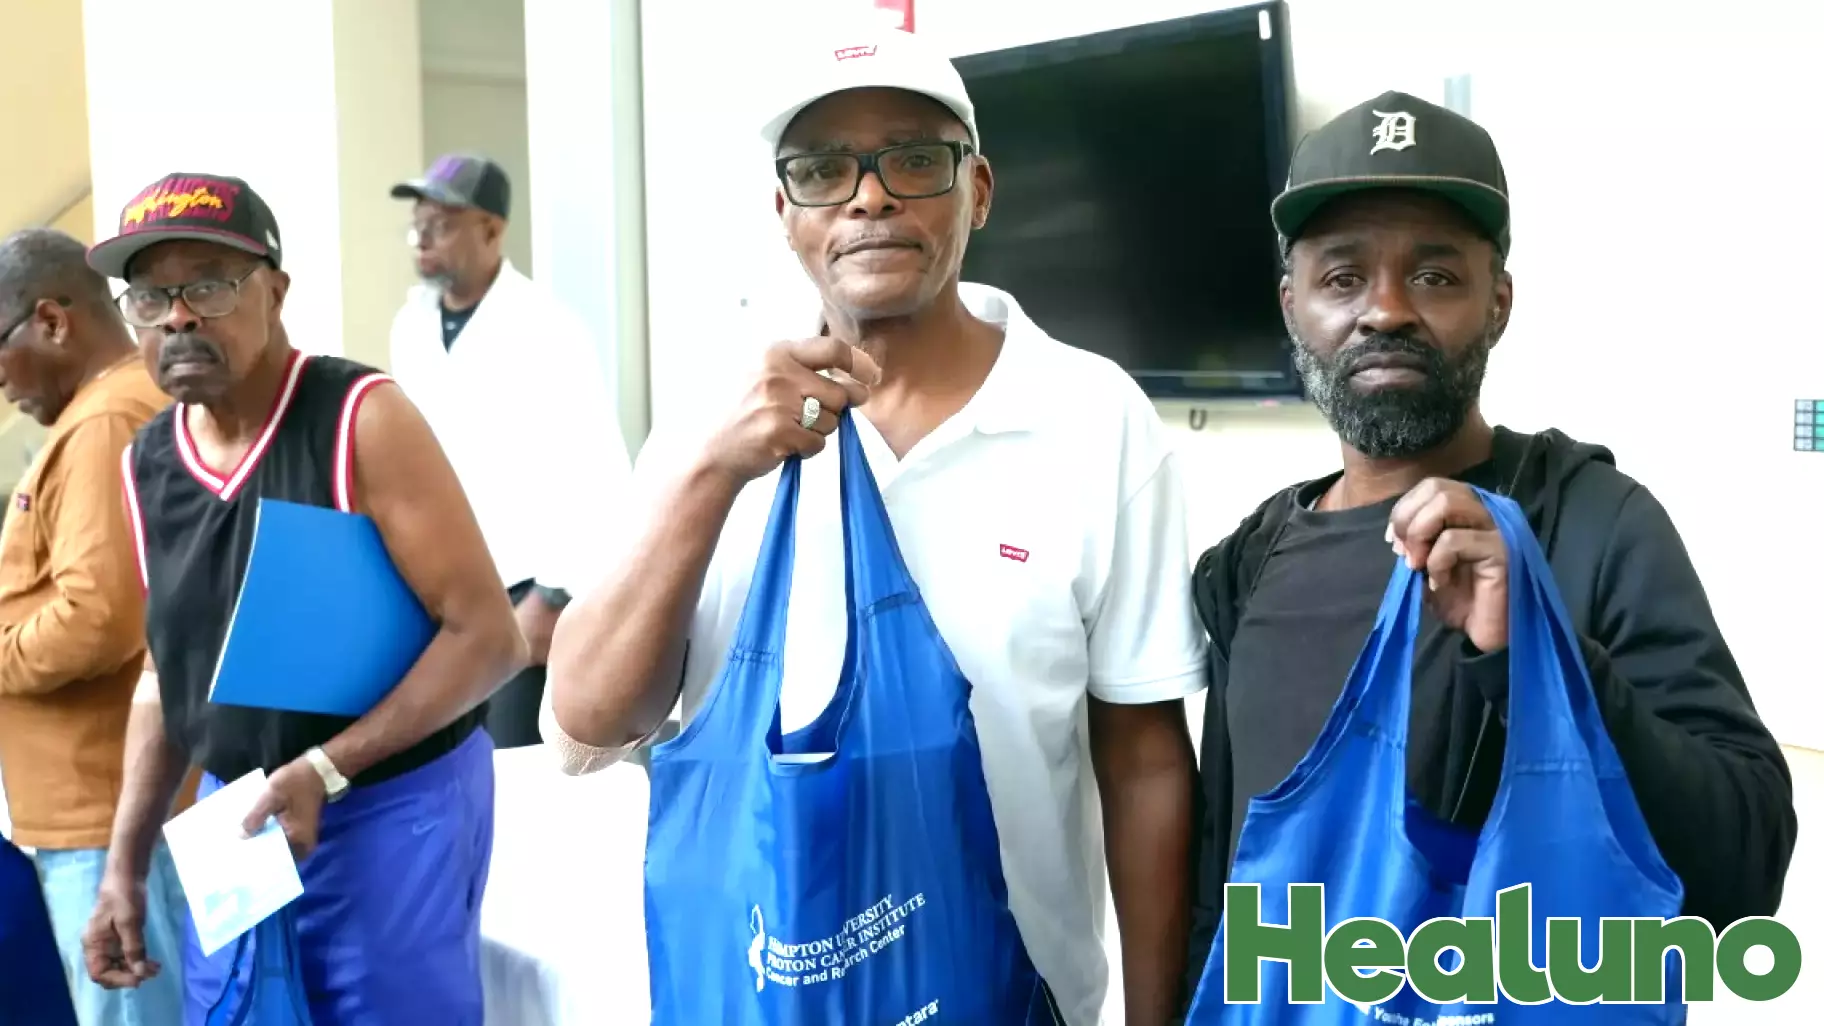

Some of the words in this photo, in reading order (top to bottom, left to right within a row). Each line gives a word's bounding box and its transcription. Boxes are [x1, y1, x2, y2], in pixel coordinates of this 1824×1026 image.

[1370, 109, 1417, 155] D
[820, 937, 857, 967] CAR
[858, 892, 926, 944] INSTITUTE
[835, 893, 893, 947] UVERSITY
[802, 969, 828, 985] and
[831, 947, 868, 980] Rarch
[869, 924, 905, 953] Center
